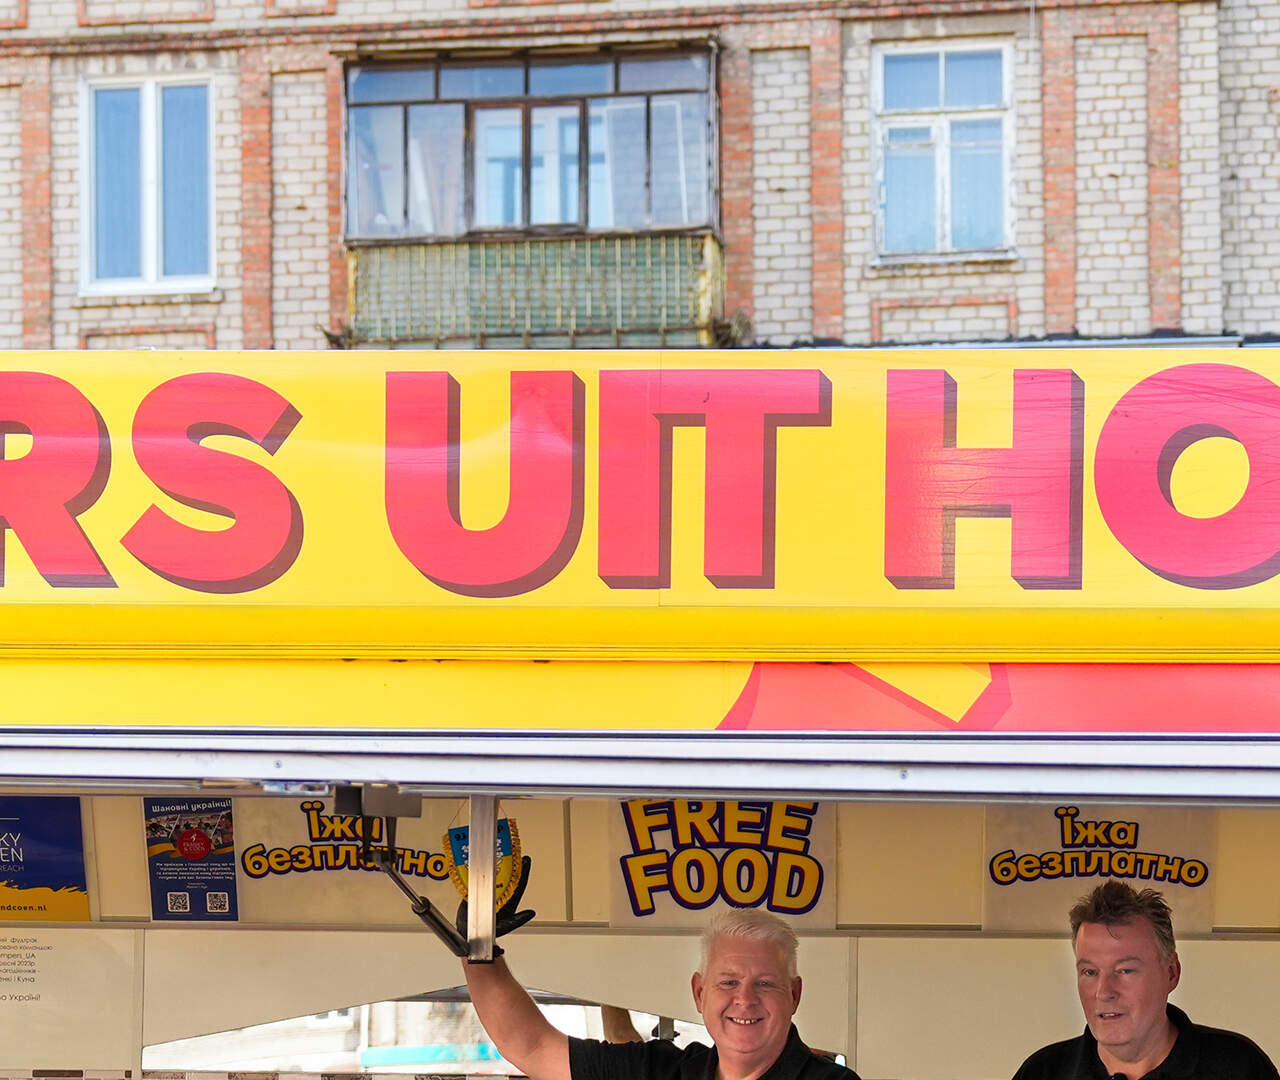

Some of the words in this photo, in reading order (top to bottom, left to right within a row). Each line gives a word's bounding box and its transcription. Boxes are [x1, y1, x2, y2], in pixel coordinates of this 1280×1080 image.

[385, 369, 832, 597] UIT
[151, 802, 189, 812] Шановні
[621, 799, 819, 854] FREE
[1055, 806, 1139, 848] Їжа
[620, 846, 824, 917] FOOD
[990, 850, 1208, 887] безплатно
